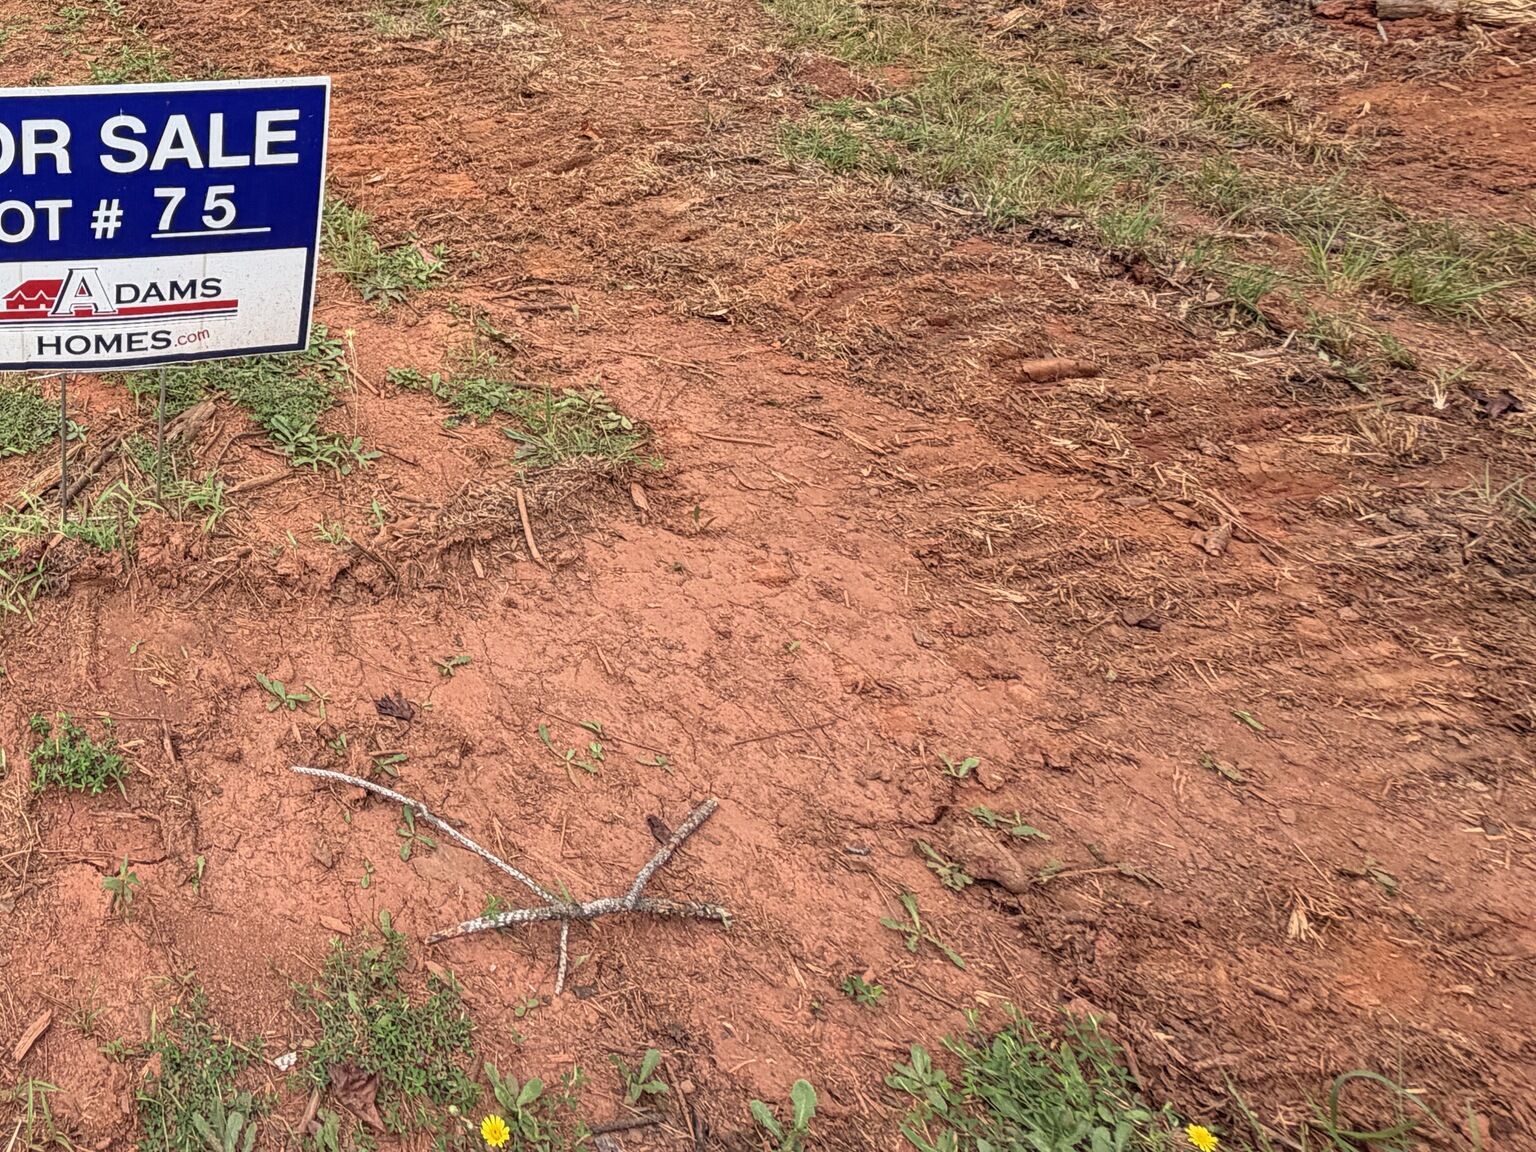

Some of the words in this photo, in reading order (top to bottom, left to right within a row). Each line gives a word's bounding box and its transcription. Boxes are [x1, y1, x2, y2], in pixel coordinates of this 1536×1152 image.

[100, 109, 301, 173] SALE
[90, 198, 124, 240] #
[51, 267, 223, 315] ADAMS
